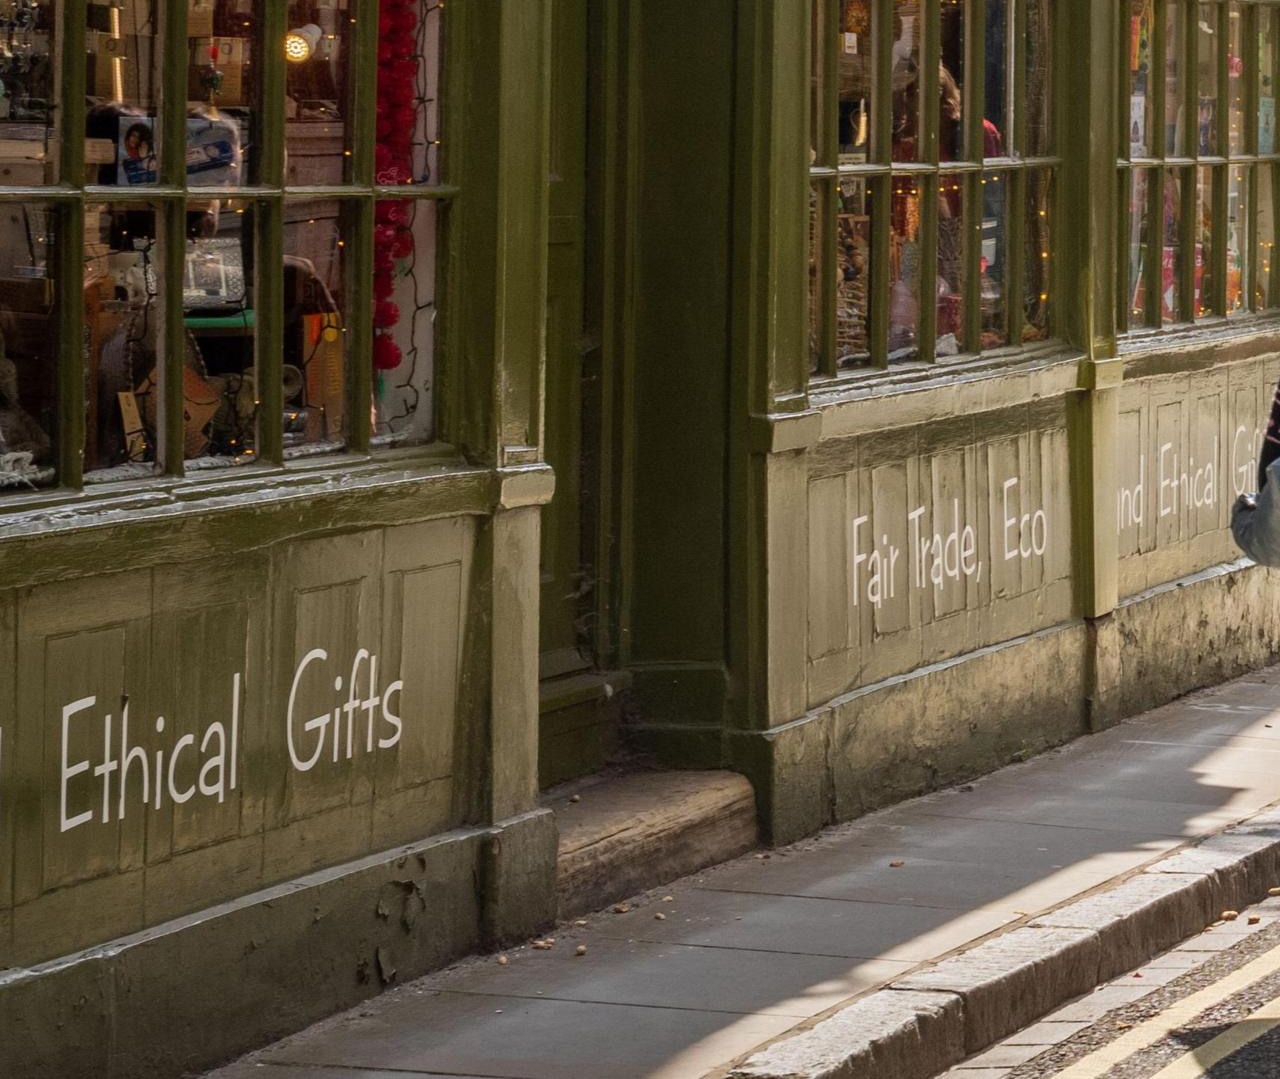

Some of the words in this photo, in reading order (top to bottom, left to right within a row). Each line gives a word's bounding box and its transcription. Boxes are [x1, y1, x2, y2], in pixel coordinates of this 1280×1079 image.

[852, 515, 900, 608] Fair
[908, 498, 983, 590] Trade,
[1003, 477, 1047, 561] Eco
[1159, 437, 1218, 518] Ethical
[60, 672, 240, 833] Ethical
[287, 648, 403, 772] Gifts
